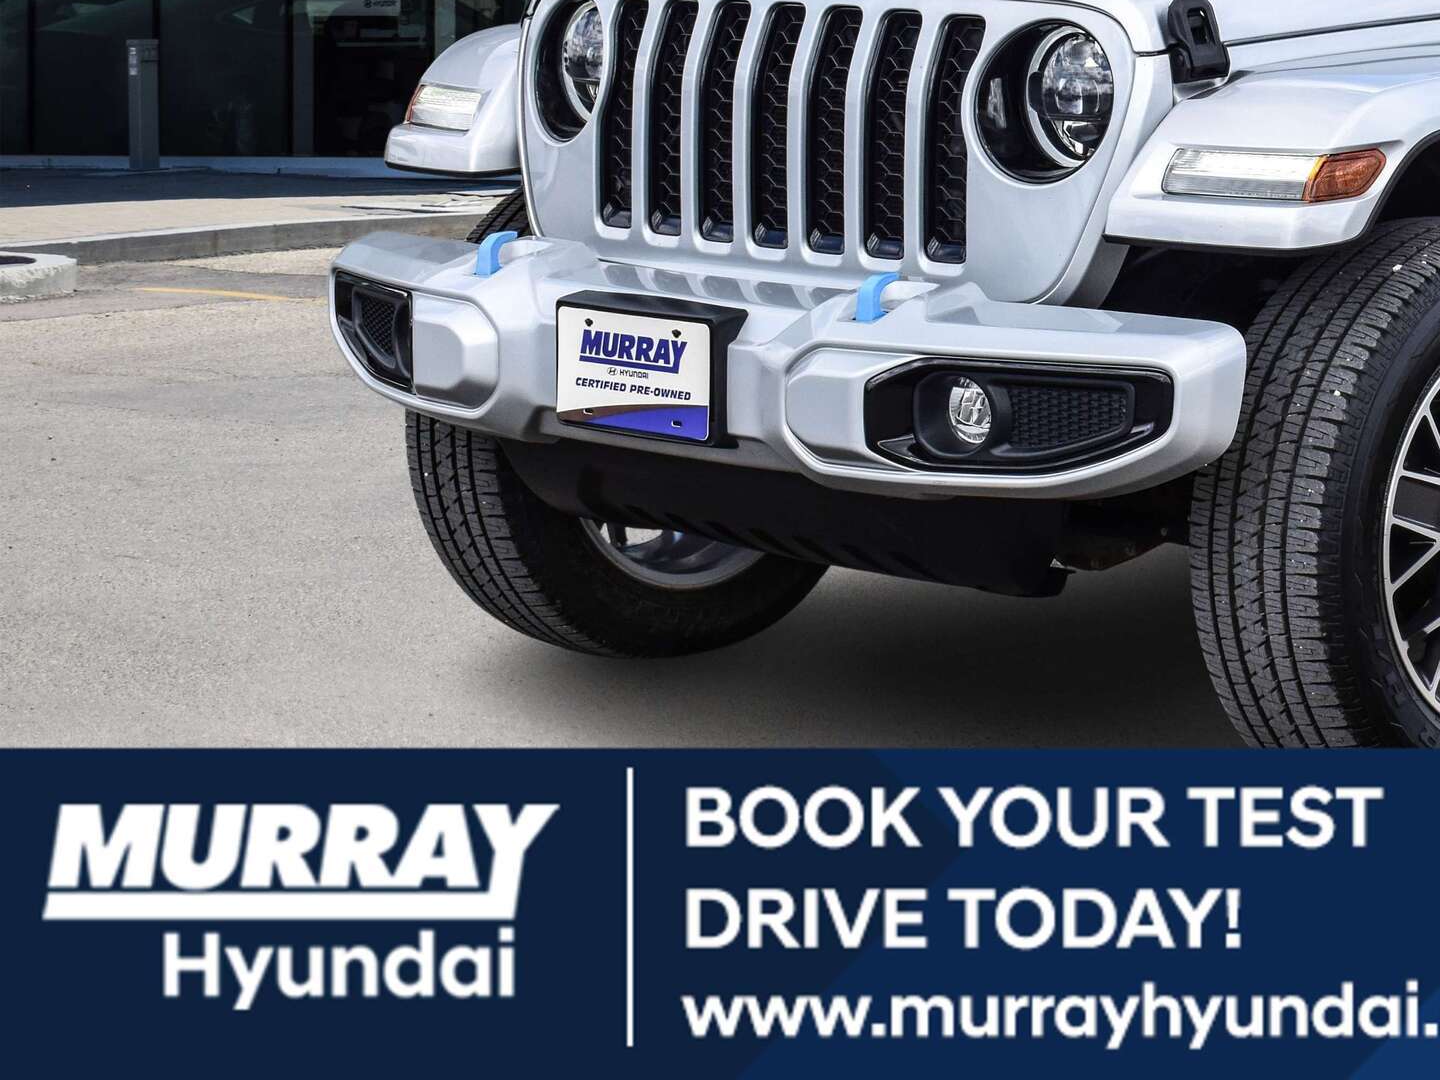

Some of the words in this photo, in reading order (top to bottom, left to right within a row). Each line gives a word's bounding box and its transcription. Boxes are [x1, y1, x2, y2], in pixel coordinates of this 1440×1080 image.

[579, 329, 688, 374] MURRAY
[619, 368, 649, 380] HYUNDAI
[575, 377, 627, 392] CERTIFIED
[629, 384, 692, 402] PRE-OWNED
